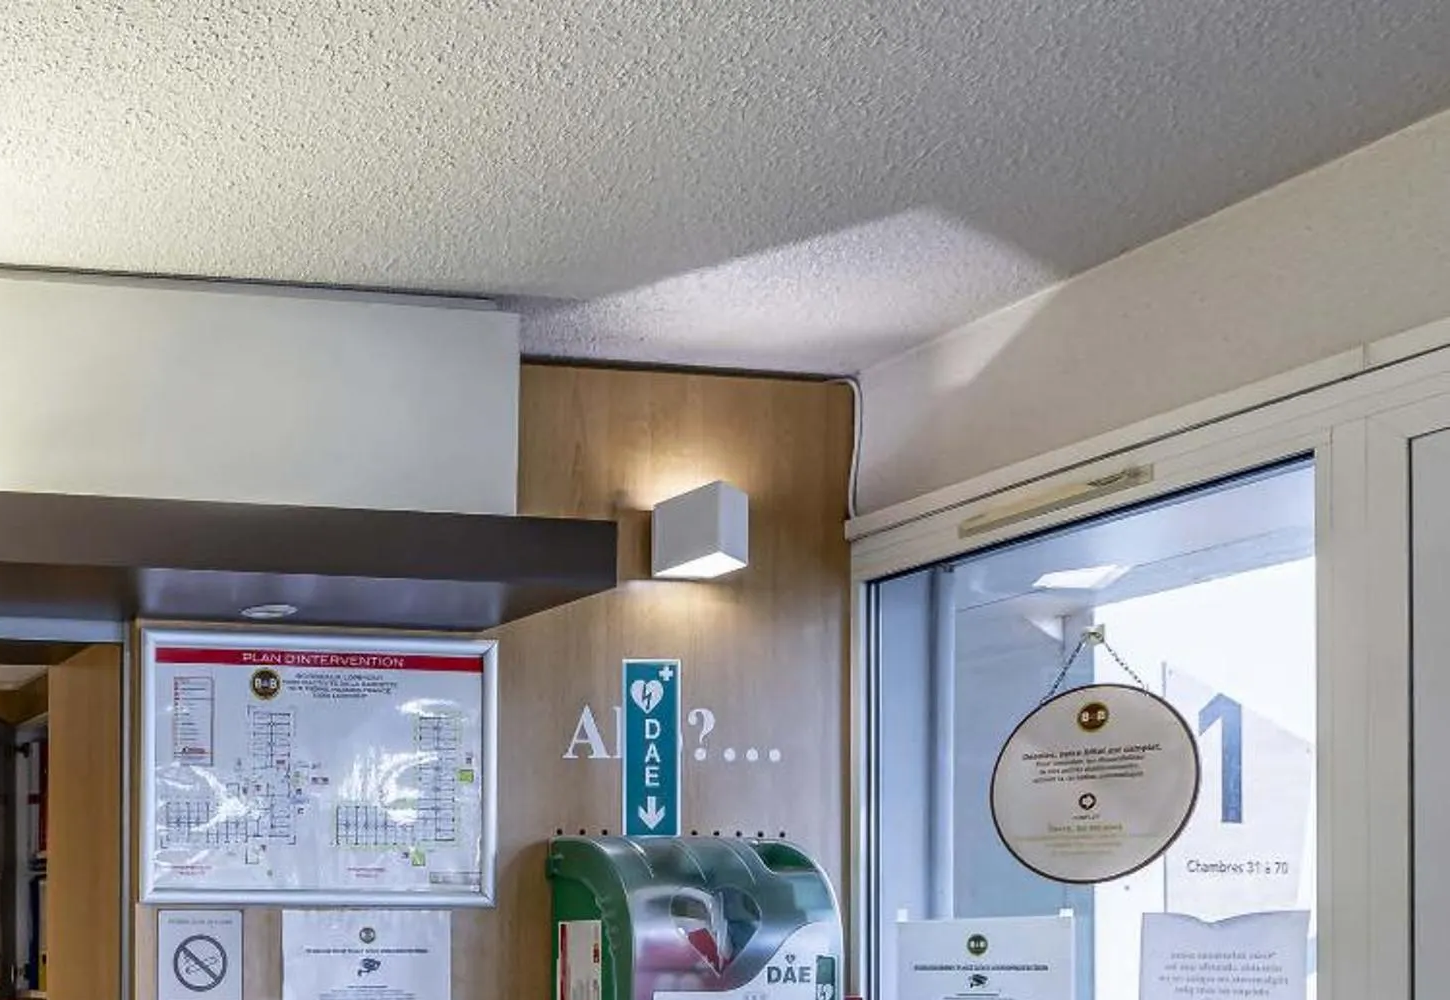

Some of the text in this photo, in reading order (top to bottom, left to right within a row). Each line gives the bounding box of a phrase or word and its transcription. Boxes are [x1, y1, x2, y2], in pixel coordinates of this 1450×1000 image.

[242, 652, 281, 663] PLAN
[644, 718, 661, 787] DAE
[1186, 859, 1244, 874] Chambres
[1247, 861, 1262, 874] 31
[1274, 861, 1288, 875] 70
[766, 966, 812, 984] DAE
